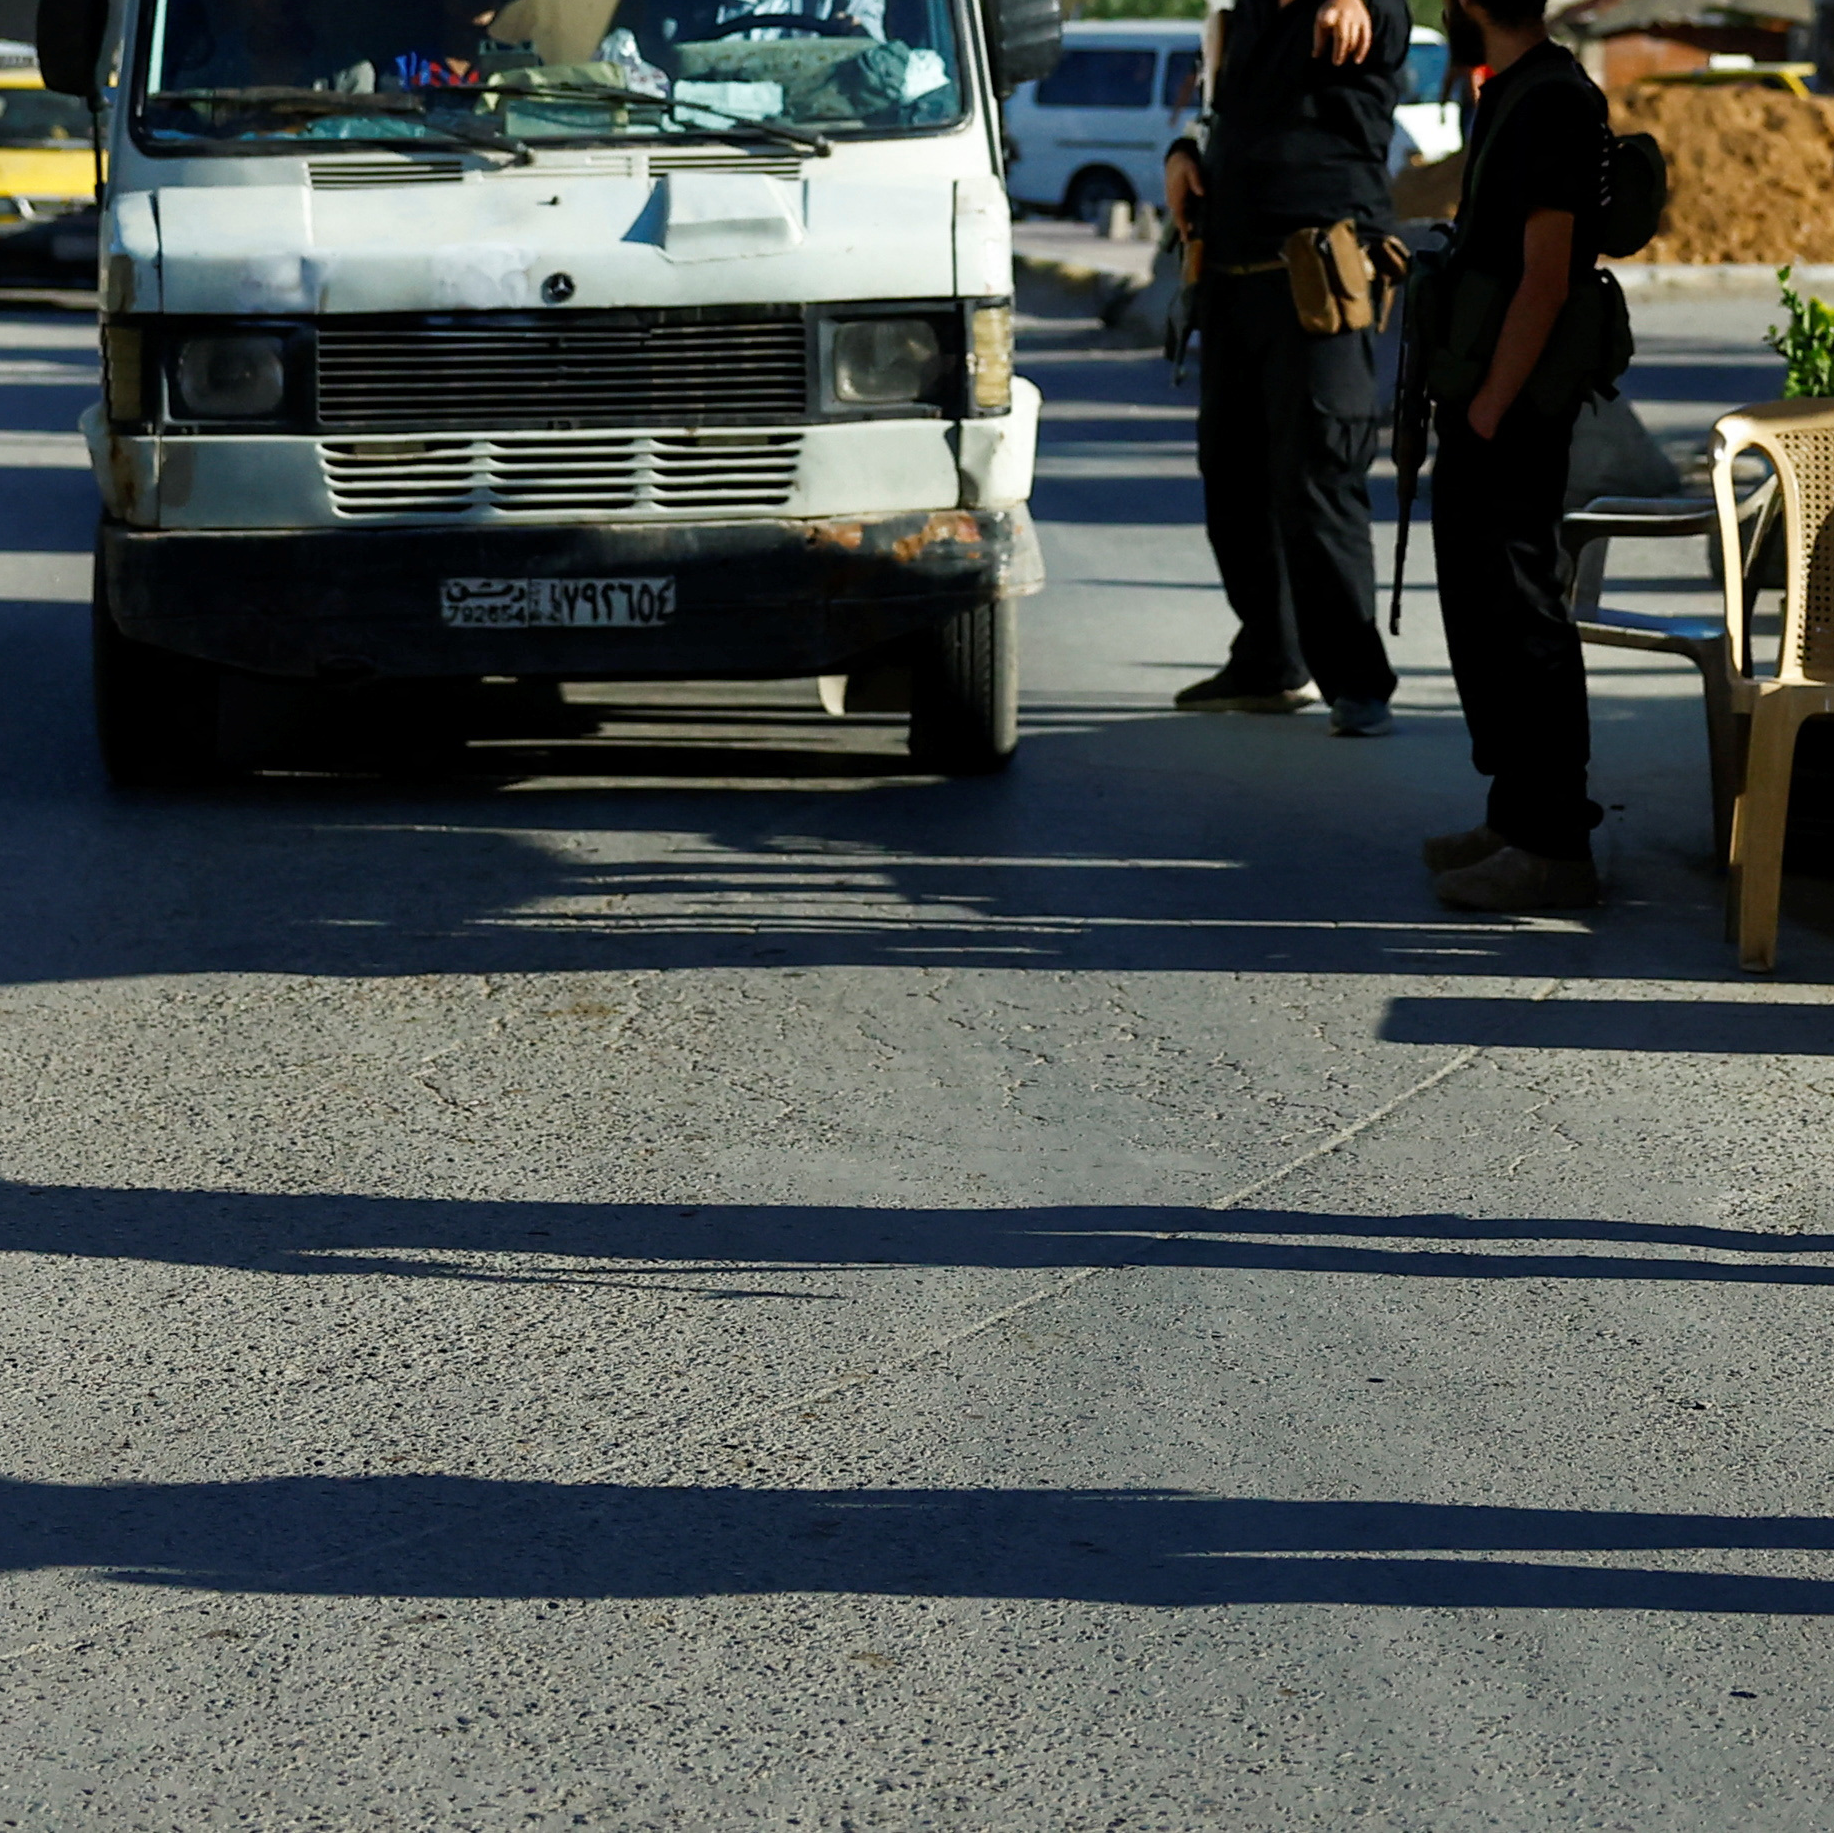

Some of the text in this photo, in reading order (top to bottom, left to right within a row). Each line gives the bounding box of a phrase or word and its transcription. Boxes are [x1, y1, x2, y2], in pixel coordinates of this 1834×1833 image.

[446, 581, 526, 603] دمشق
[563, 581, 674, 623] ٧٩٢٦٥٤
[447, 604, 526, 623] 792654
